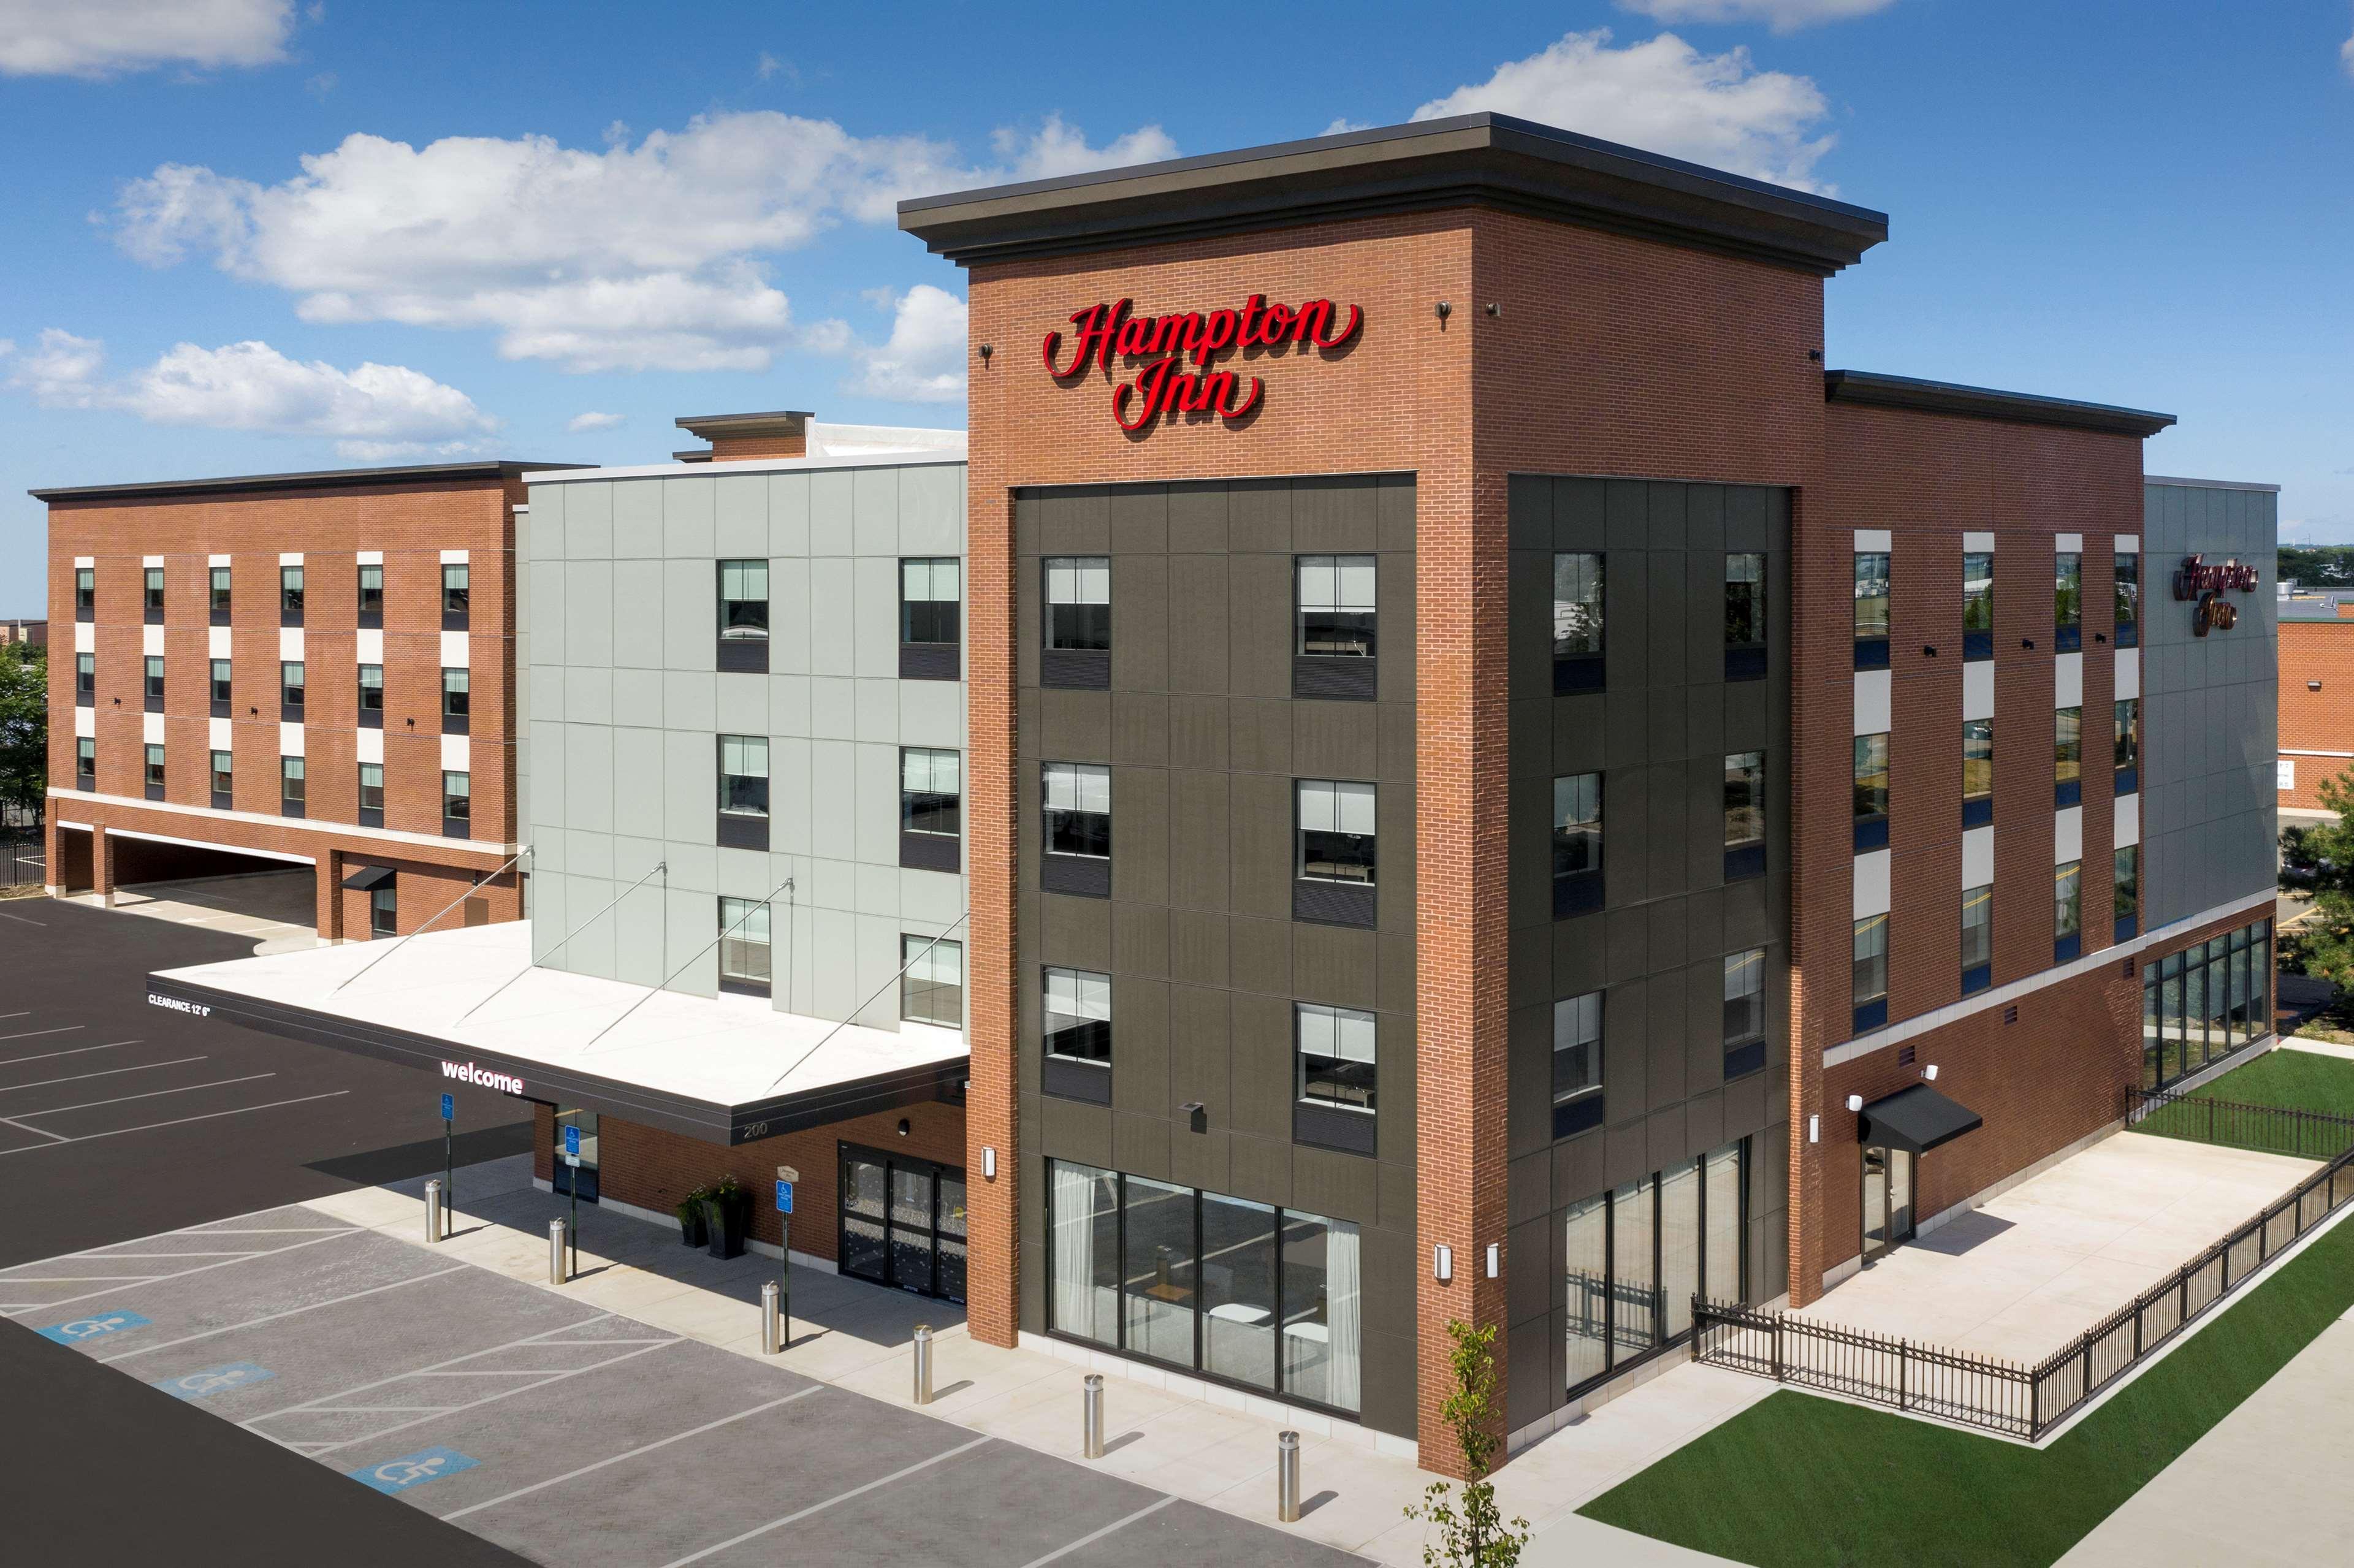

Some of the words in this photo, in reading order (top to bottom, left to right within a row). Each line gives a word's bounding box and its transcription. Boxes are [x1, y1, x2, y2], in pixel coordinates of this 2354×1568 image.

[1043, 294, 1364, 377] Hampton
[1113, 357, 1263, 430] Inn
[148, 994, 191, 1013] CLEARANCE
[191, 1004, 202, 1015] 12'
[441, 1060, 524, 1095] welcome
[744, 1122, 768, 1139] 200
